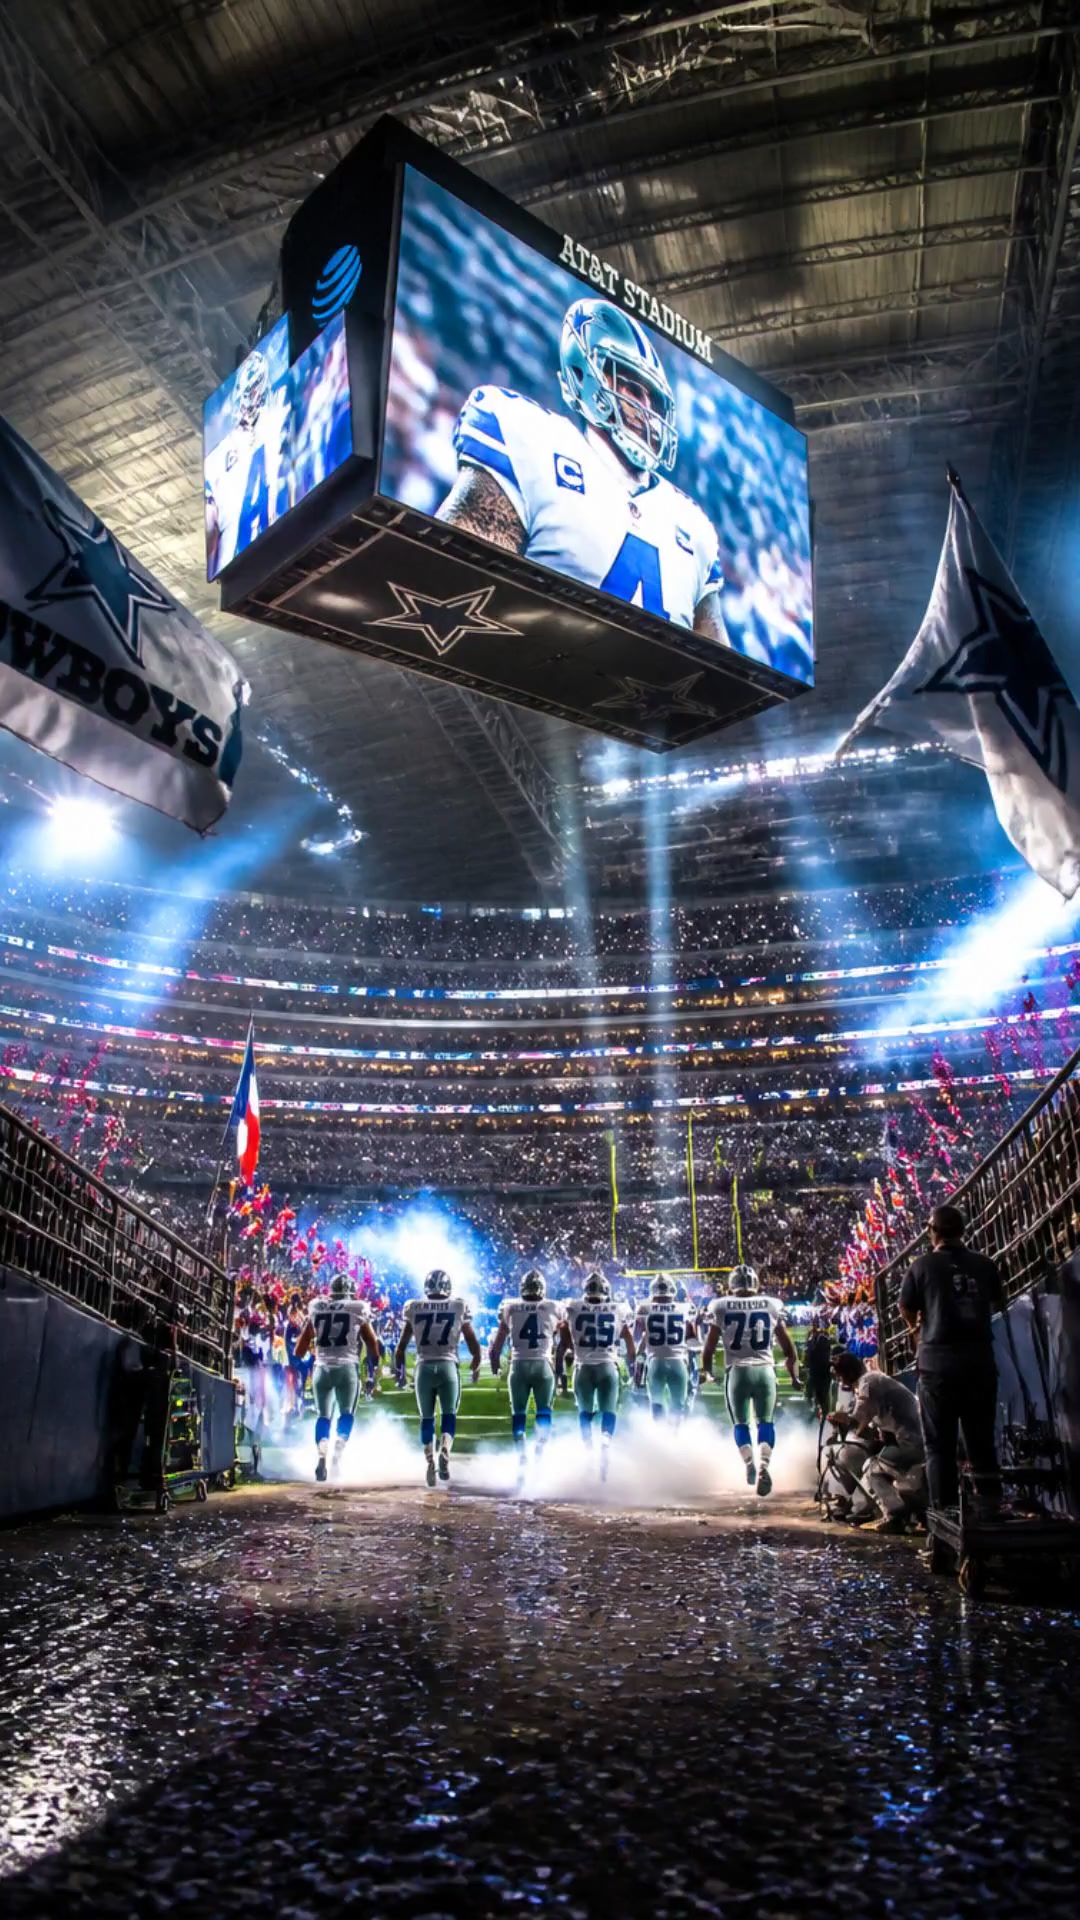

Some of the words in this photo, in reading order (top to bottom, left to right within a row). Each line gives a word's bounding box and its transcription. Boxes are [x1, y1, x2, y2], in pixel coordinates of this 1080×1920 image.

[559, 234, 619, 296] AT&T
[623, 278, 714, 364] STADIUM
[556, 454, 584, 489] C
[0, 600, 223, 768] WBOYS
[314, 1312, 350, 1347] 77
[414, 1312, 456, 1346] 77
[519, 1312, 547, 1349] 4
[724, 1311, 771, 1350] 70
